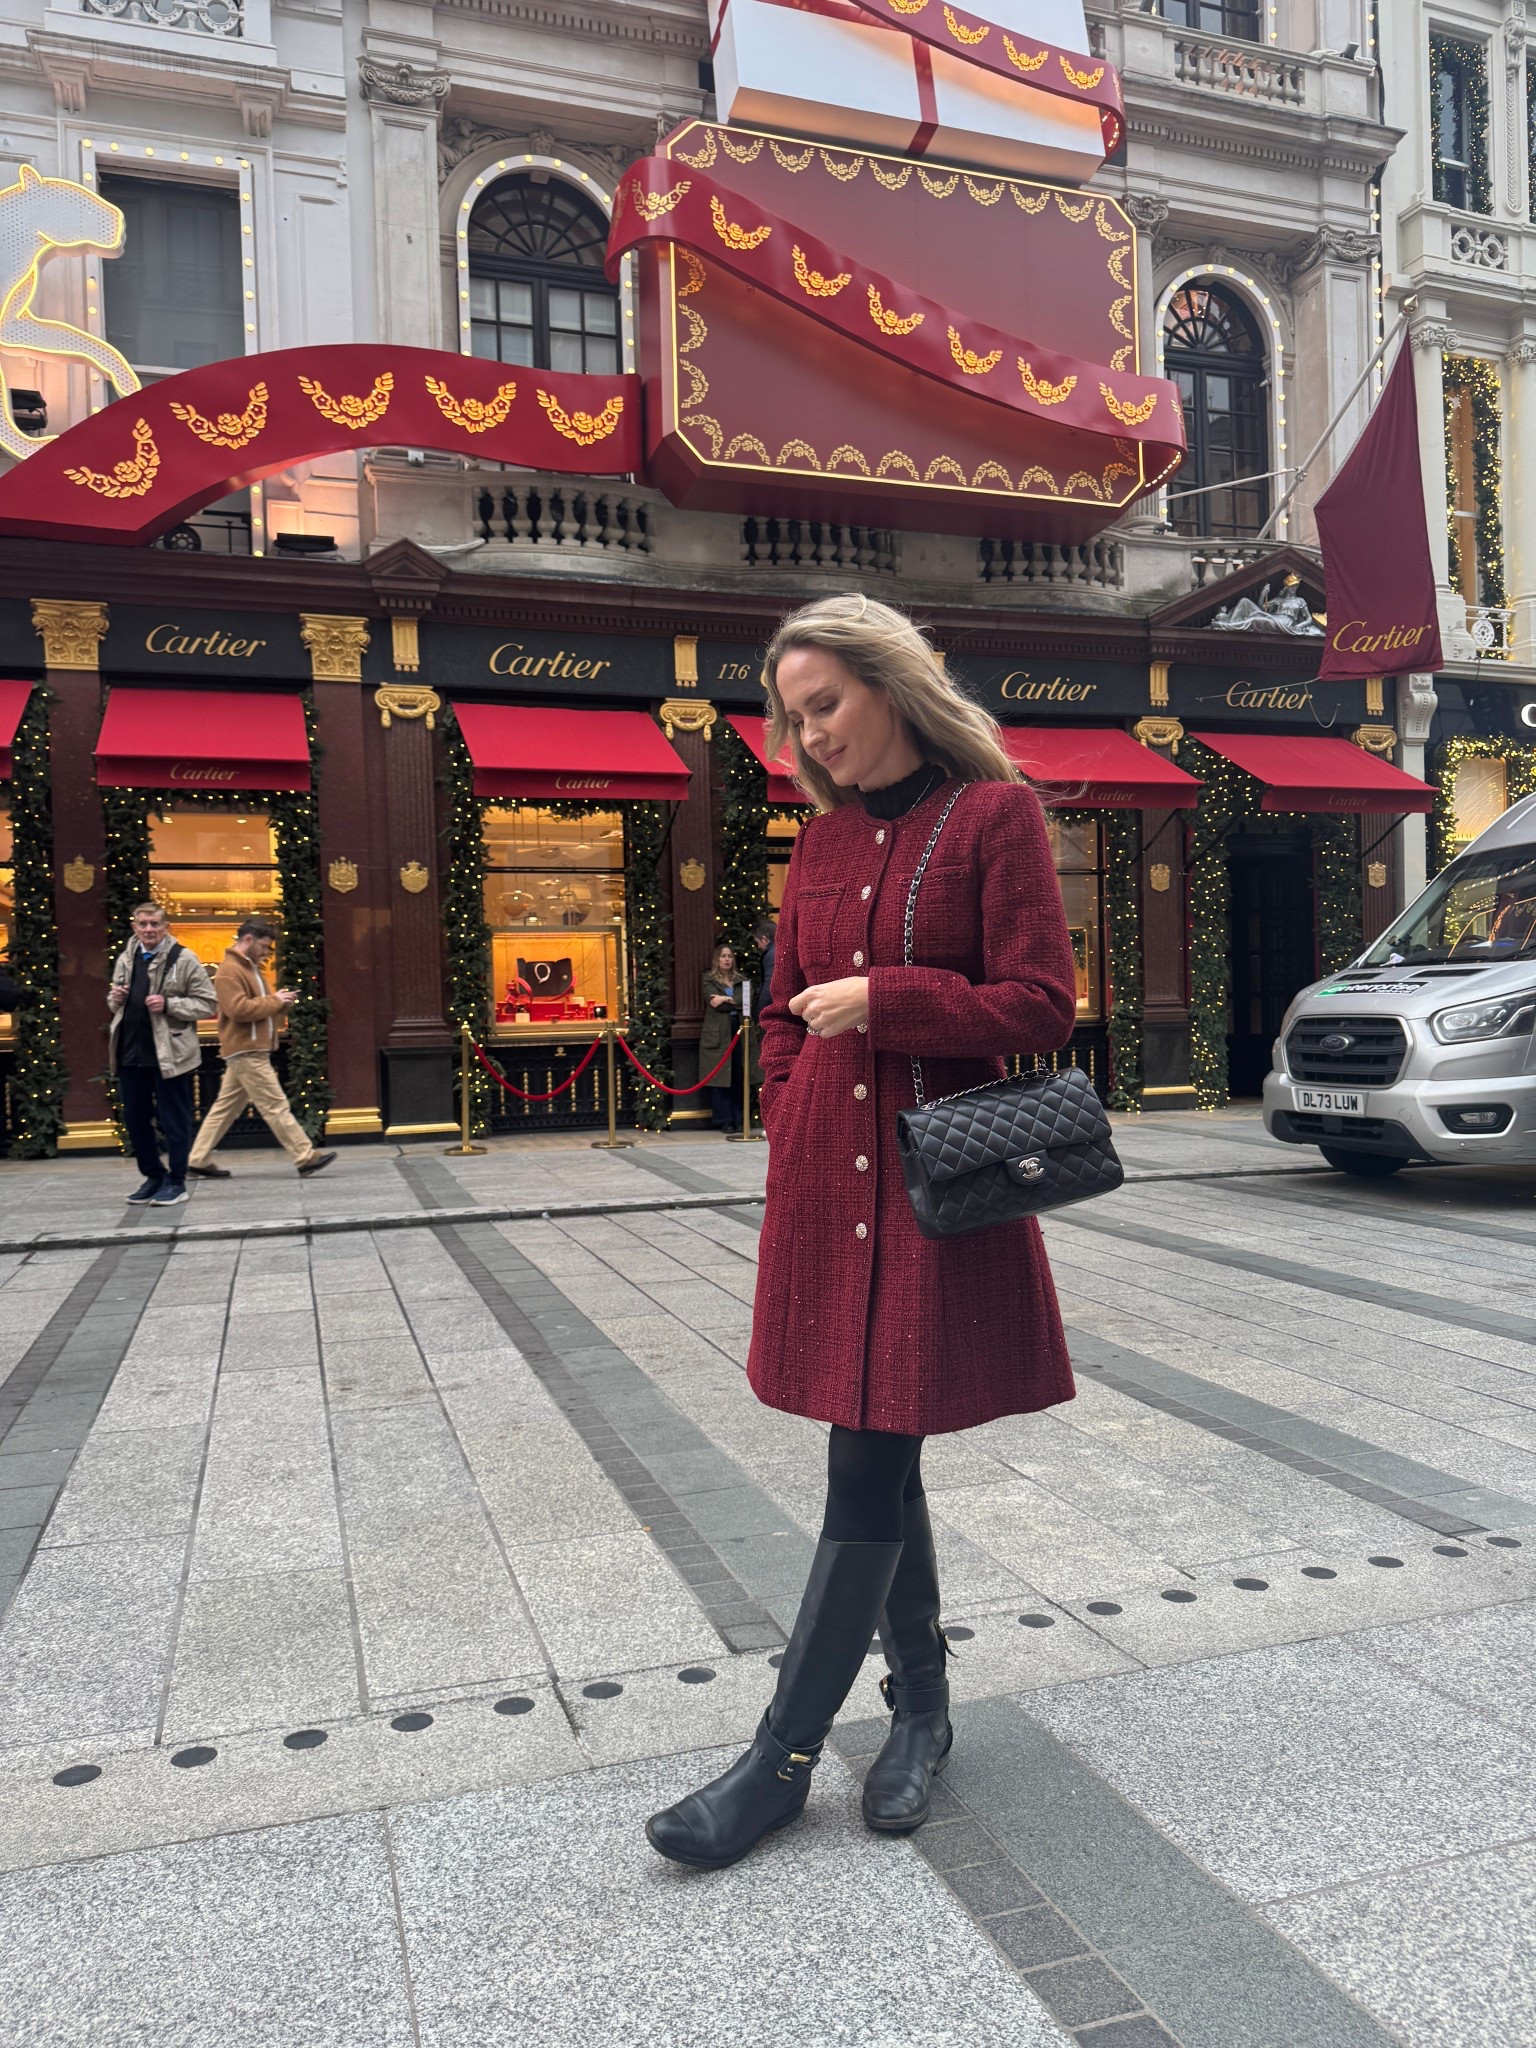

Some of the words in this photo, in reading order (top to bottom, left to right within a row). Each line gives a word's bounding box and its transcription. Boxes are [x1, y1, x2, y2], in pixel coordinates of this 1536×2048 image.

[145, 624, 267, 657] Cartier
[1332, 620, 1432, 653] Cartier
[489, 643, 611, 679] Cartier
[717, 663, 751, 680] 176
[1001, 671, 1097, 701] Cartier
[1226, 680, 1313, 710] Cartier
[170, 762, 240, 781] Cartier
[555, 775, 614, 790] Cartier
[1090, 786, 1136, 802] Cartier
[1303, 1092, 1332, 1109] DL73
[1334, 1094, 1358, 1111] LUW
